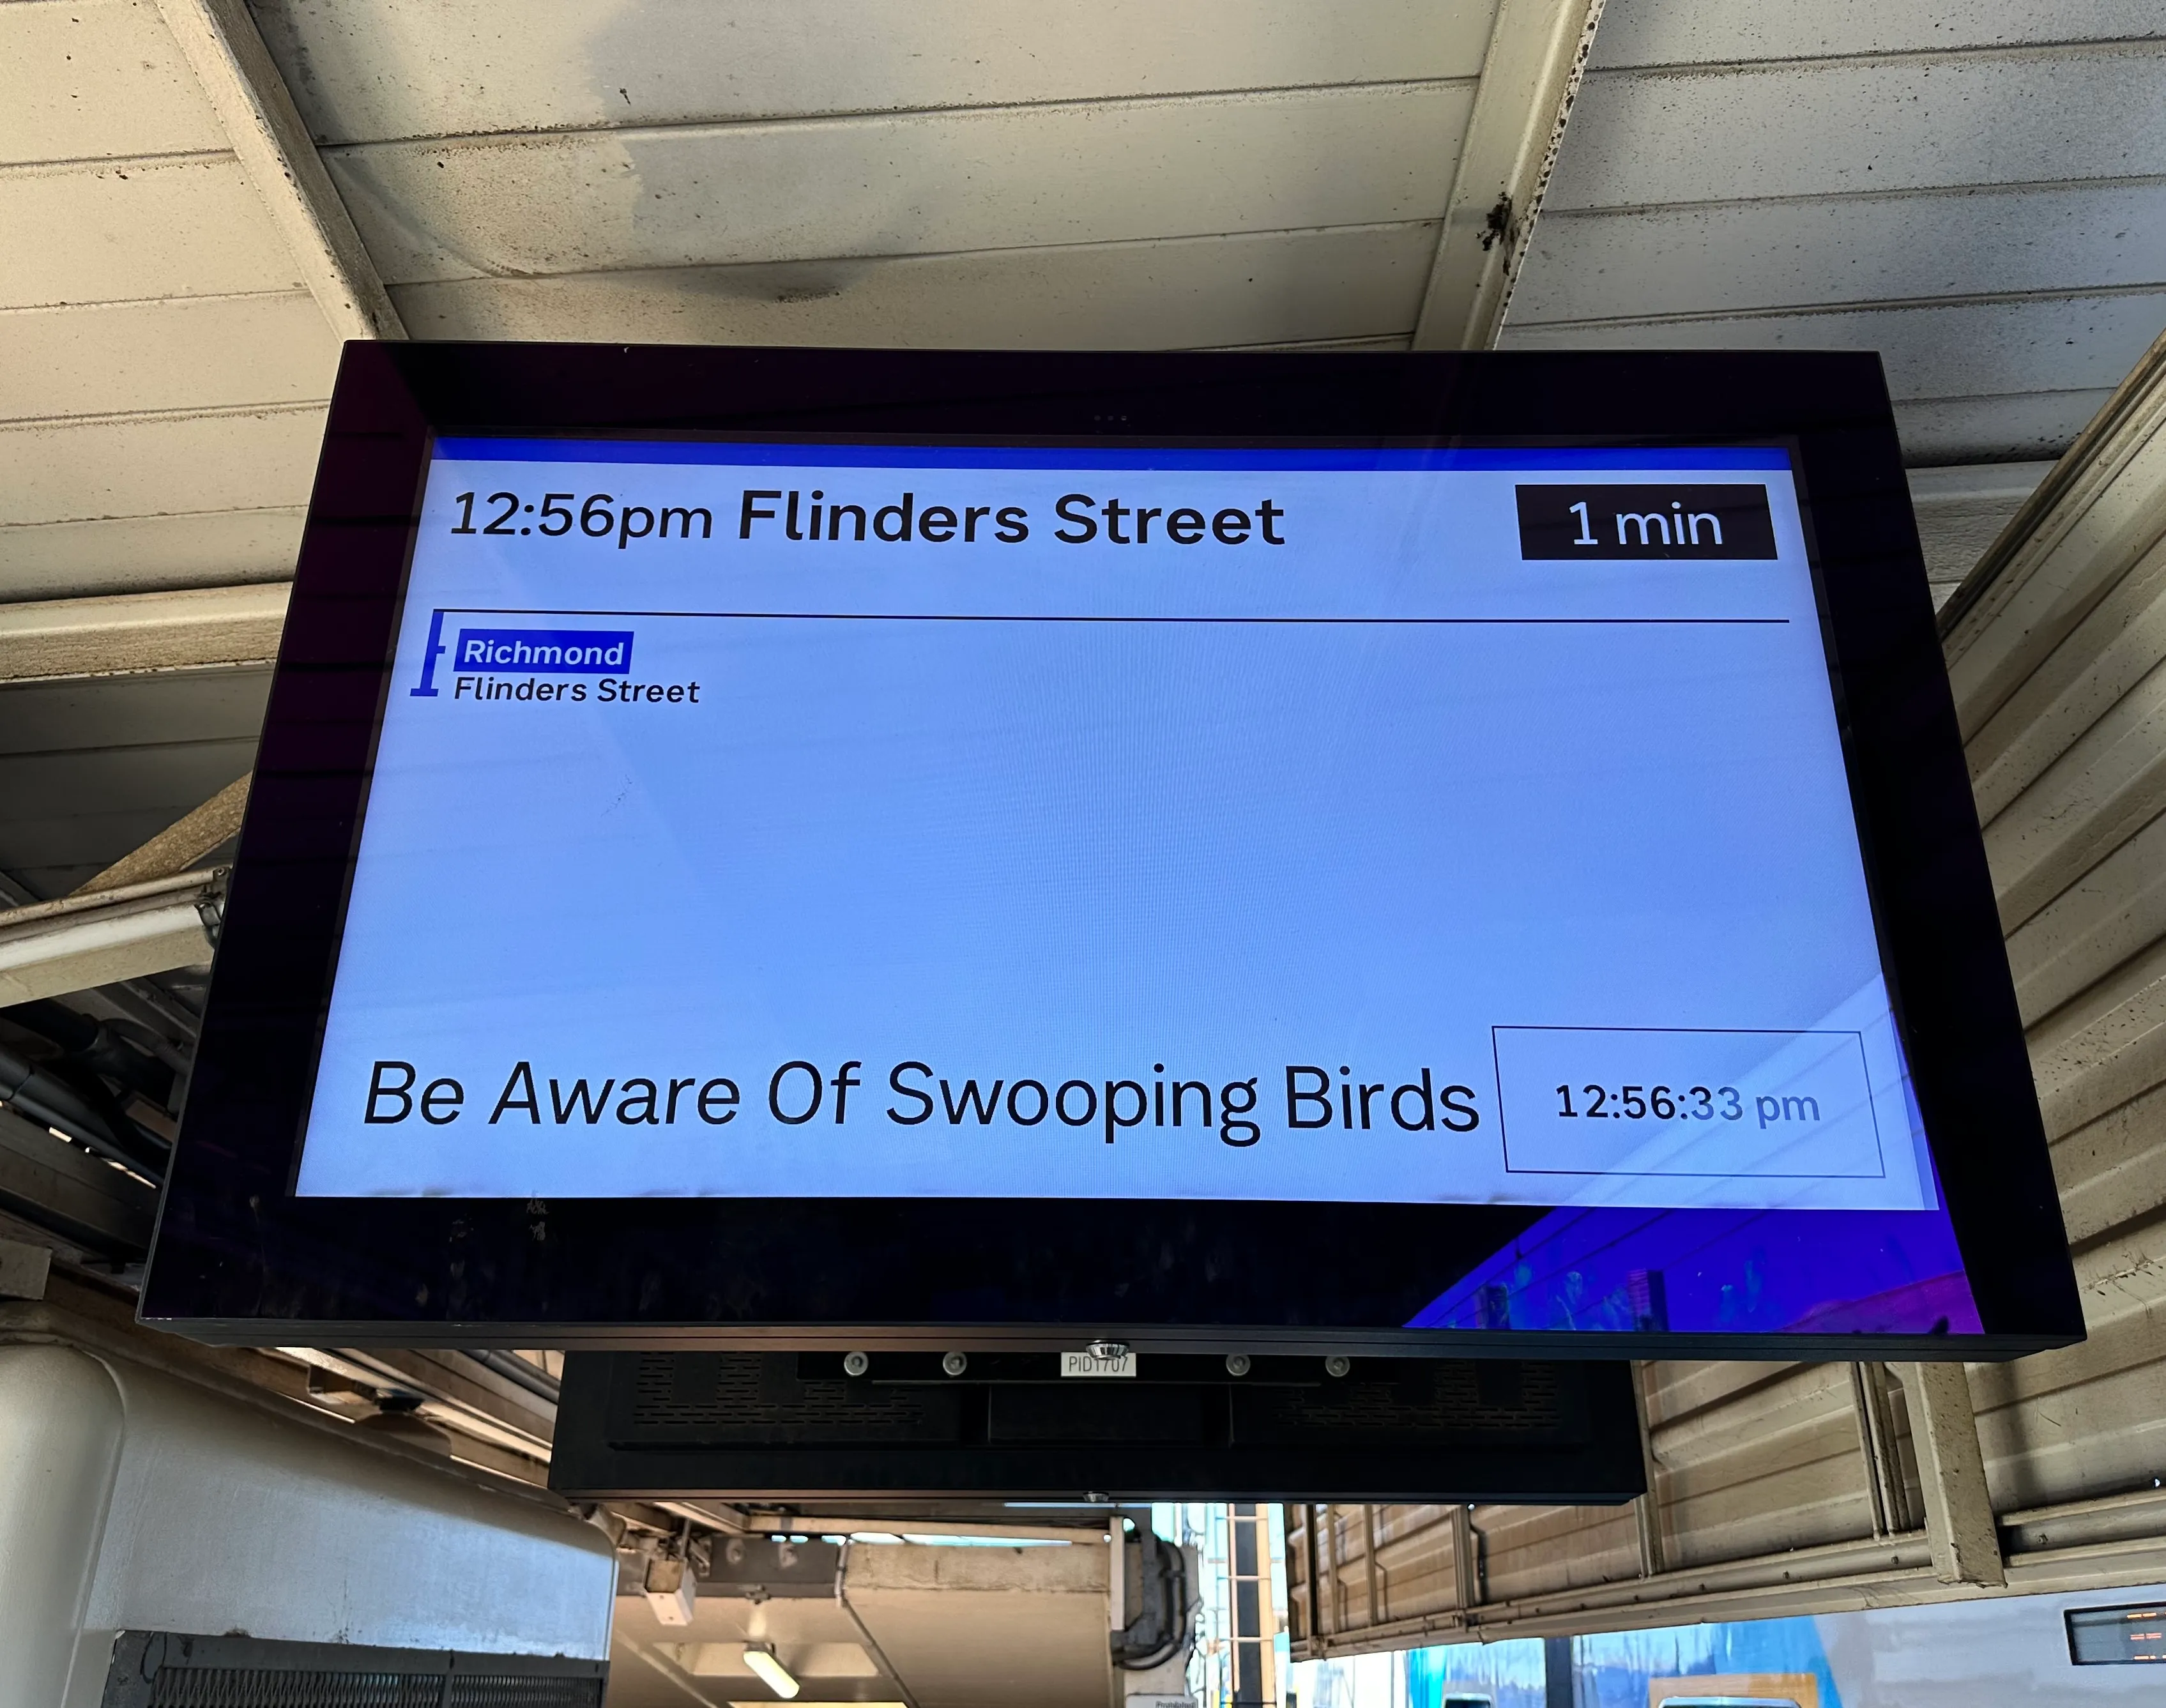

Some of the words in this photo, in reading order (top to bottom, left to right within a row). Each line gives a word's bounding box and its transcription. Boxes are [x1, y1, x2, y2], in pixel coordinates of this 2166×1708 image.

[451, 492, 712, 549] 12:56pm
[739, 490, 1029, 544] Flinders
[1054, 494, 1285, 545] Street
[1569, 501, 1598, 545] 1
[1615, 501, 1723, 545] min
[464, 639, 624, 666] Richmond
[454, 676, 587, 702] Flinders
[597, 678, 701, 703] Street
[364, 1061, 464, 1125] Be
[487, 1061, 740, 1125] Aware
[768, 1060, 862, 1125] Of
[886, 1061, 1261, 1147] Swooping
[1285, 1065, 1479, 1132] Birds
[1556, 1084, 1743, 1120] 12:56:33
[1756, 1095, 1820, 1129] pm
[1069, 1355, 1128, 1372] PID1707
